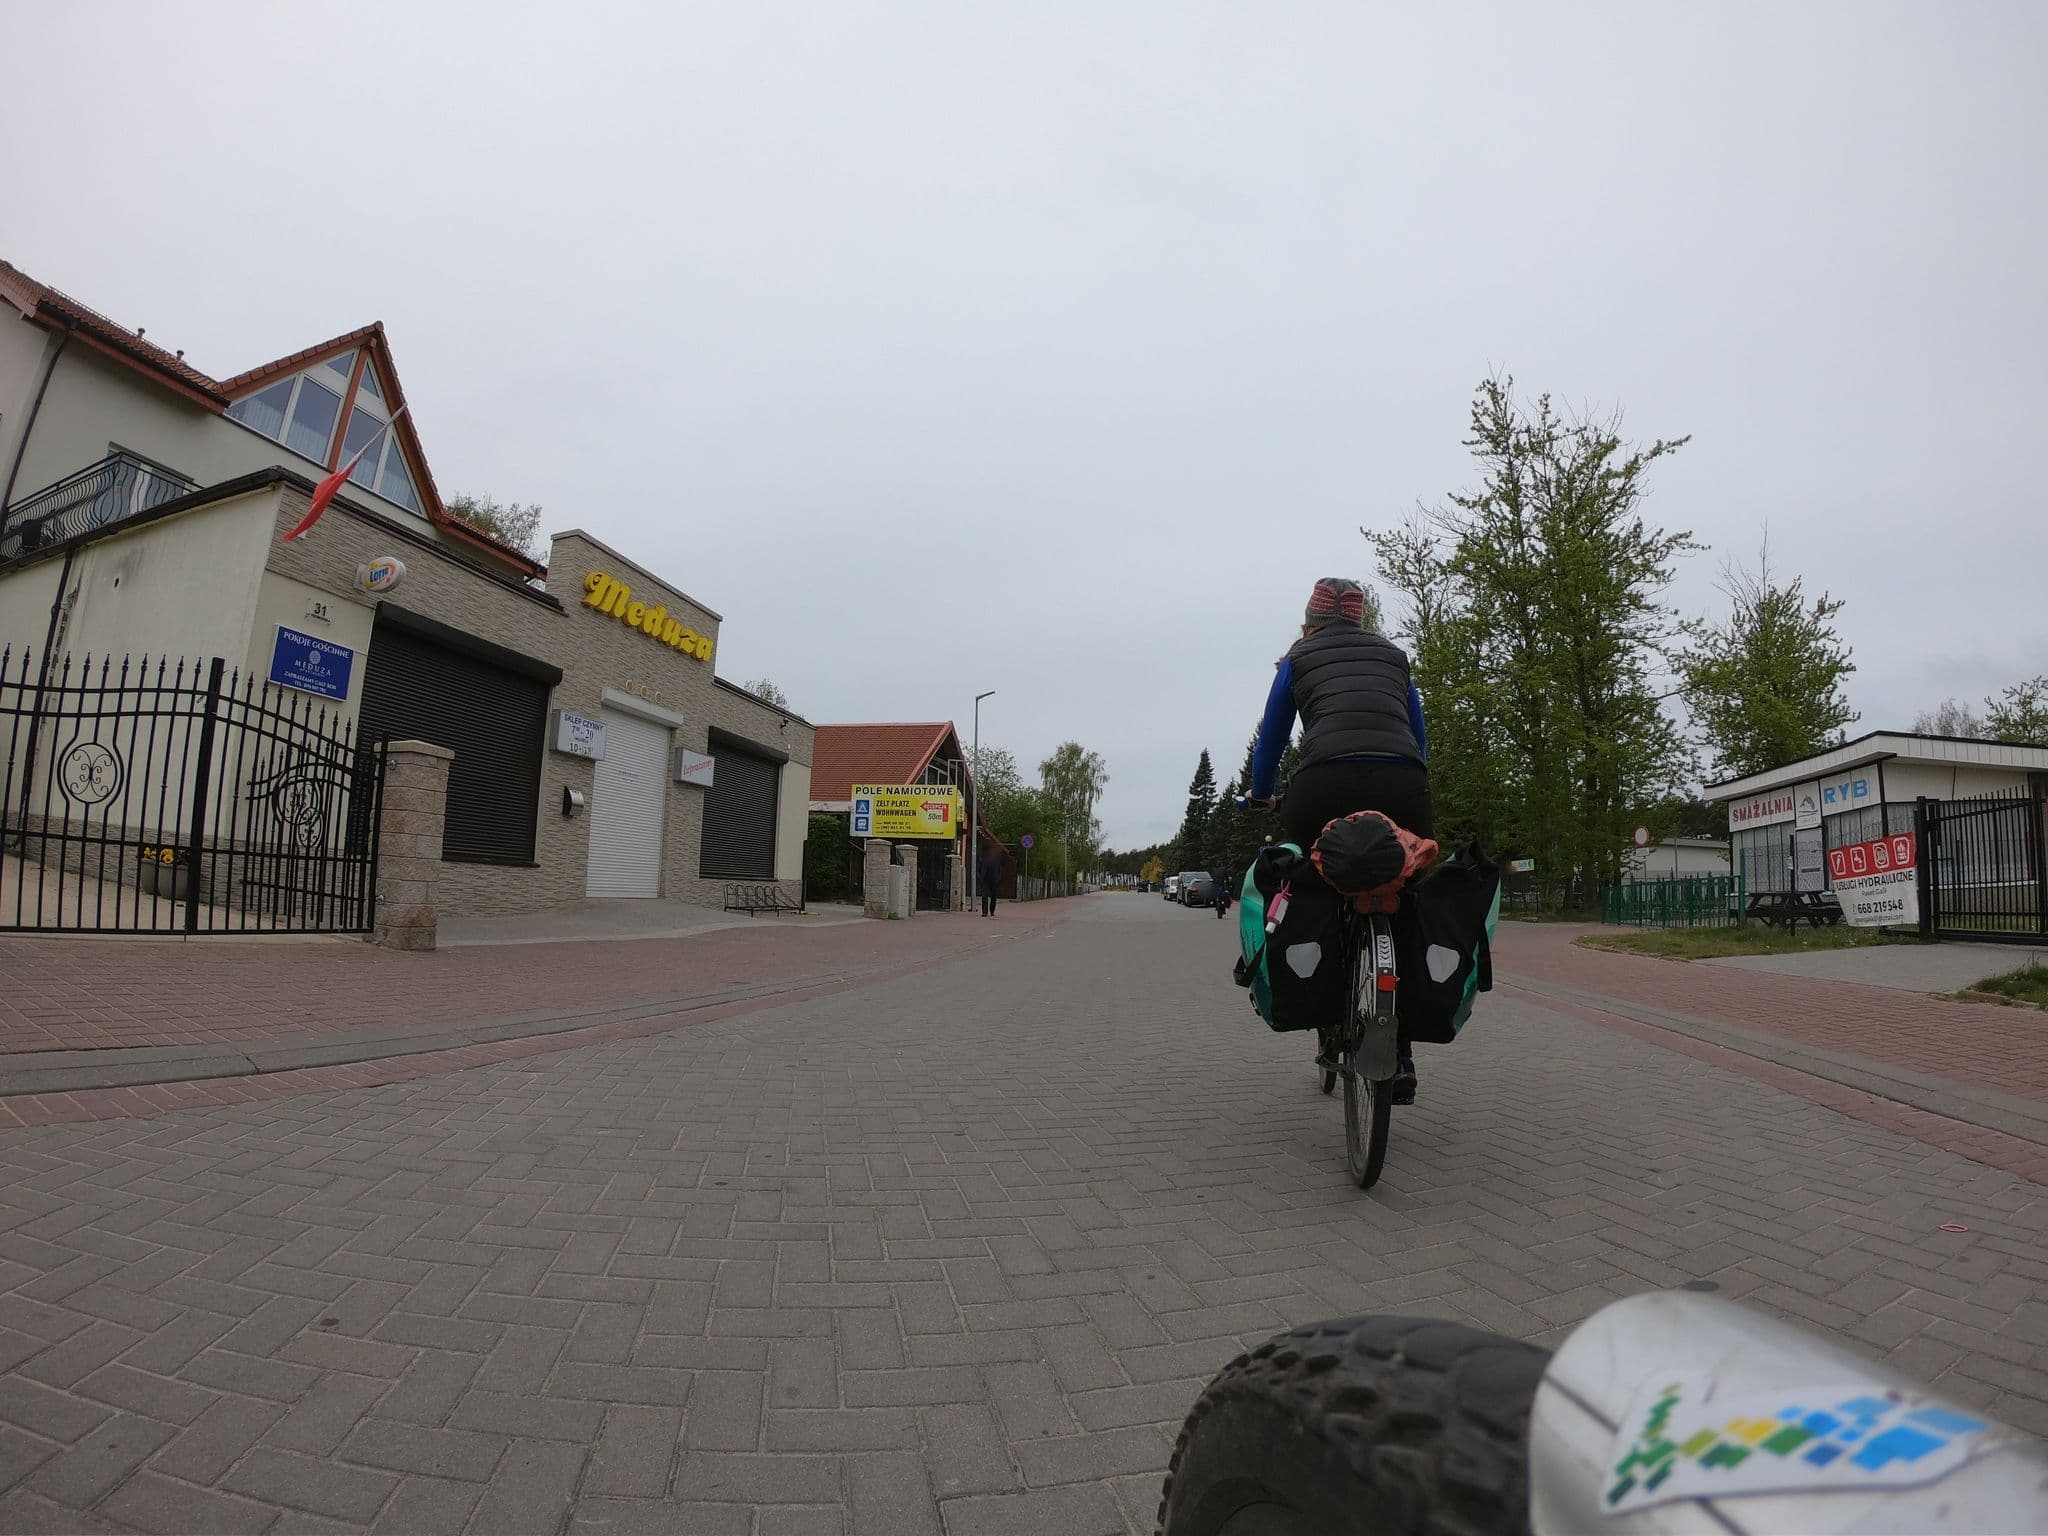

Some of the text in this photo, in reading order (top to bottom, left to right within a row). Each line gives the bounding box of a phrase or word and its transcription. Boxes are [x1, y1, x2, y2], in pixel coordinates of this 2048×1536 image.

[314, 602, 328, 617] 31
[582, 569, 714, 662] Meduza
[283, 631, 350, 659] POKOJE GOŚCINNE
[294, 660, 331, 676] MEDUZA
[855, 786, 953, 796] POLE NAMIOTOWE
[1823, 779, 1868, 804] RYB
[876, 809, 917, 817] WOHNWAGEN
[1732, 796, 1793, 823] SMAŻALNIA
[1857, 899, 1904, 914] 668 219 548
